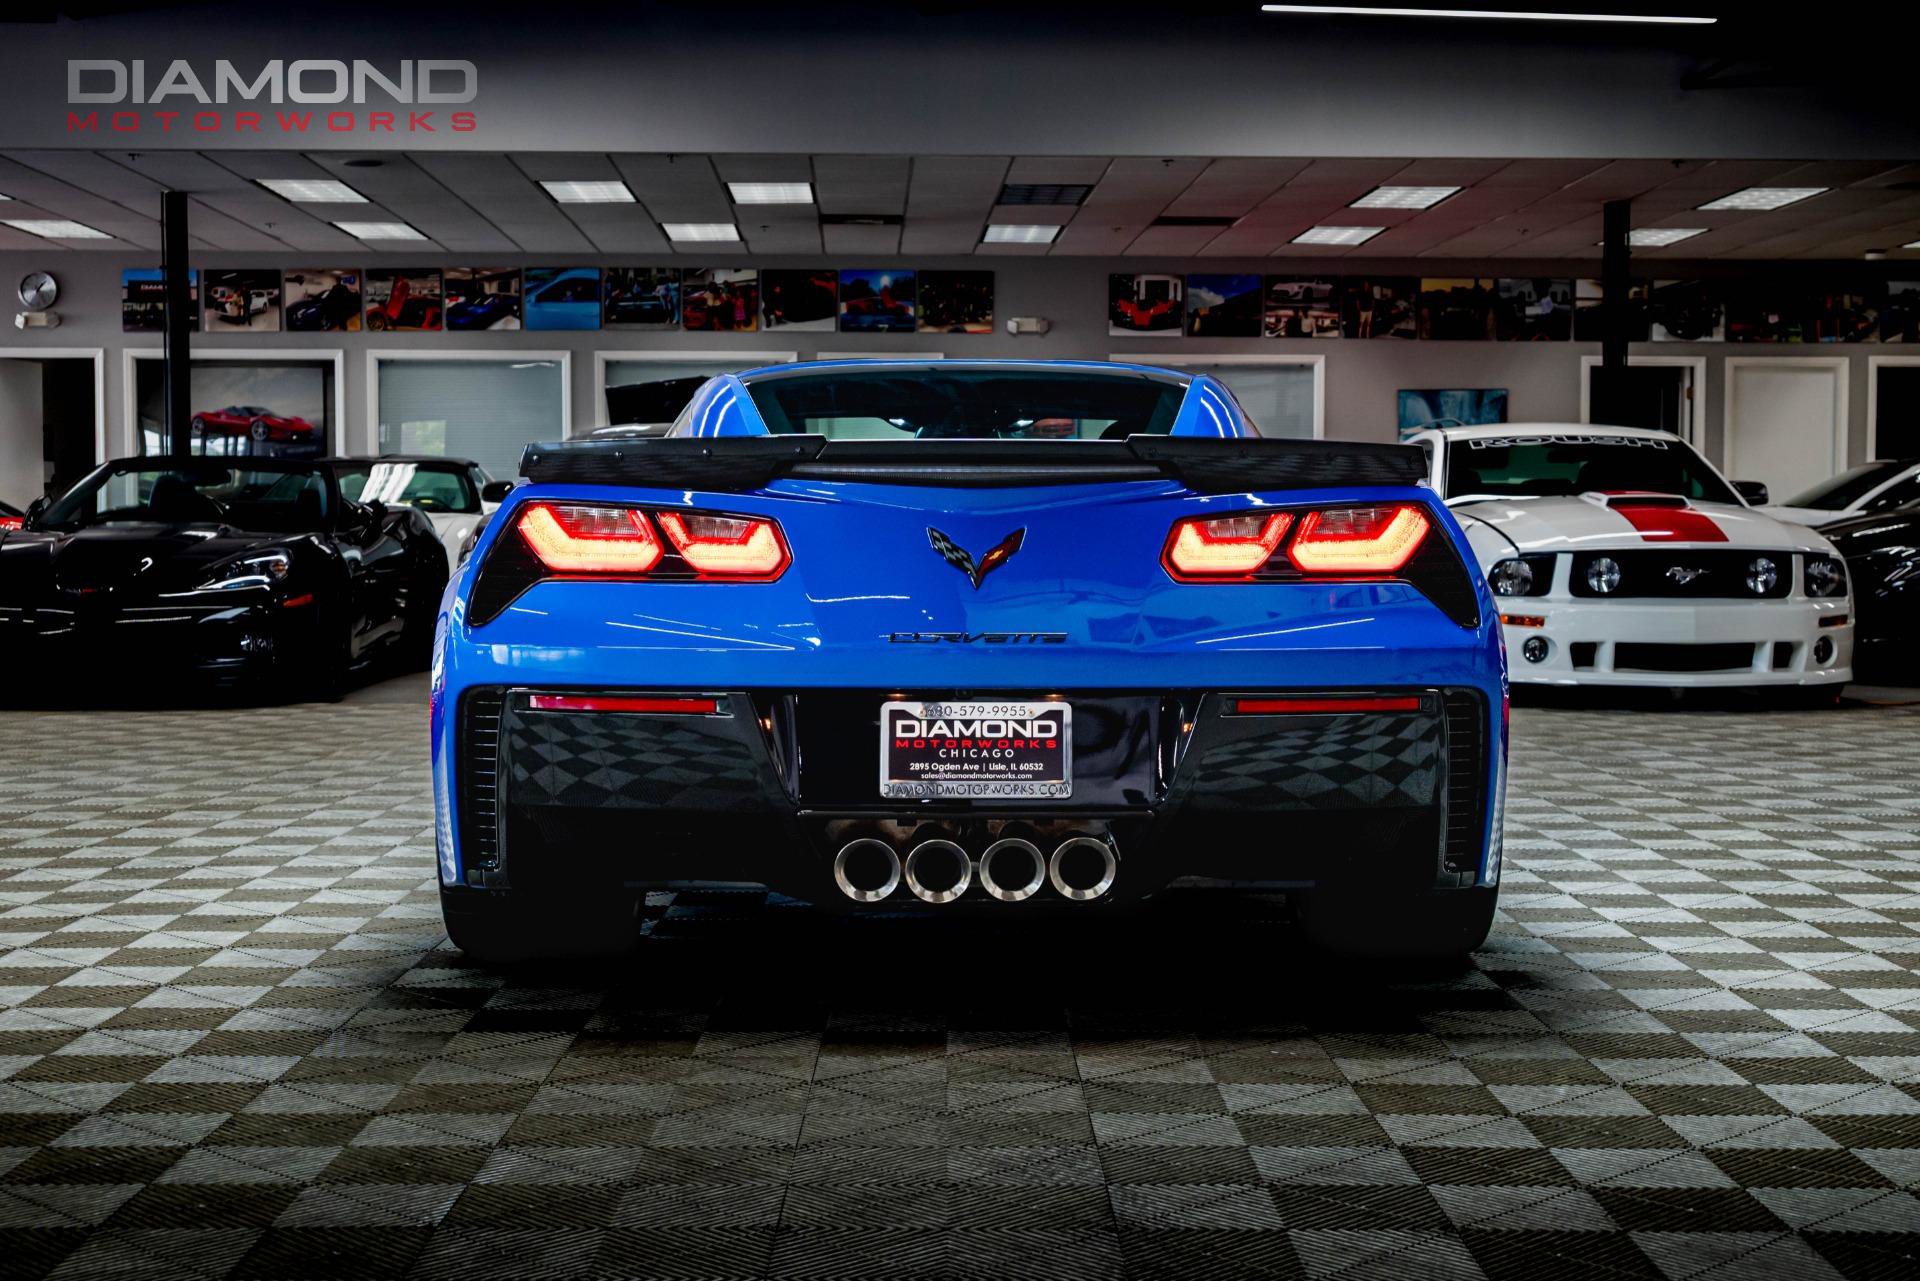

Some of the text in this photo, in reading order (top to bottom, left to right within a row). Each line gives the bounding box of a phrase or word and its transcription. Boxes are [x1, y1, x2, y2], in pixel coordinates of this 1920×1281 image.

[1469, 435, 1669, 450] ROUSH
[926, 705, 1027, 717] 630-579-9955
[895, 719, 1058, 738] DIAMOND
[895, 739, 1057, 749] MOTORWORKS
[939, 749, 1015, 758] CHICAGO
[909, 763, 930, 771] 2895
[931, 763, 961, 772] Ogden
[963, 763, 980, 771] Ave
[989, 763, 1009, 772] Lisle,
[1011, 763, 1018, 771] IL
[1019, 763, 1044, 771] 60532
[920, 772, 1033, 780] sales@diamondmotorworks.com
